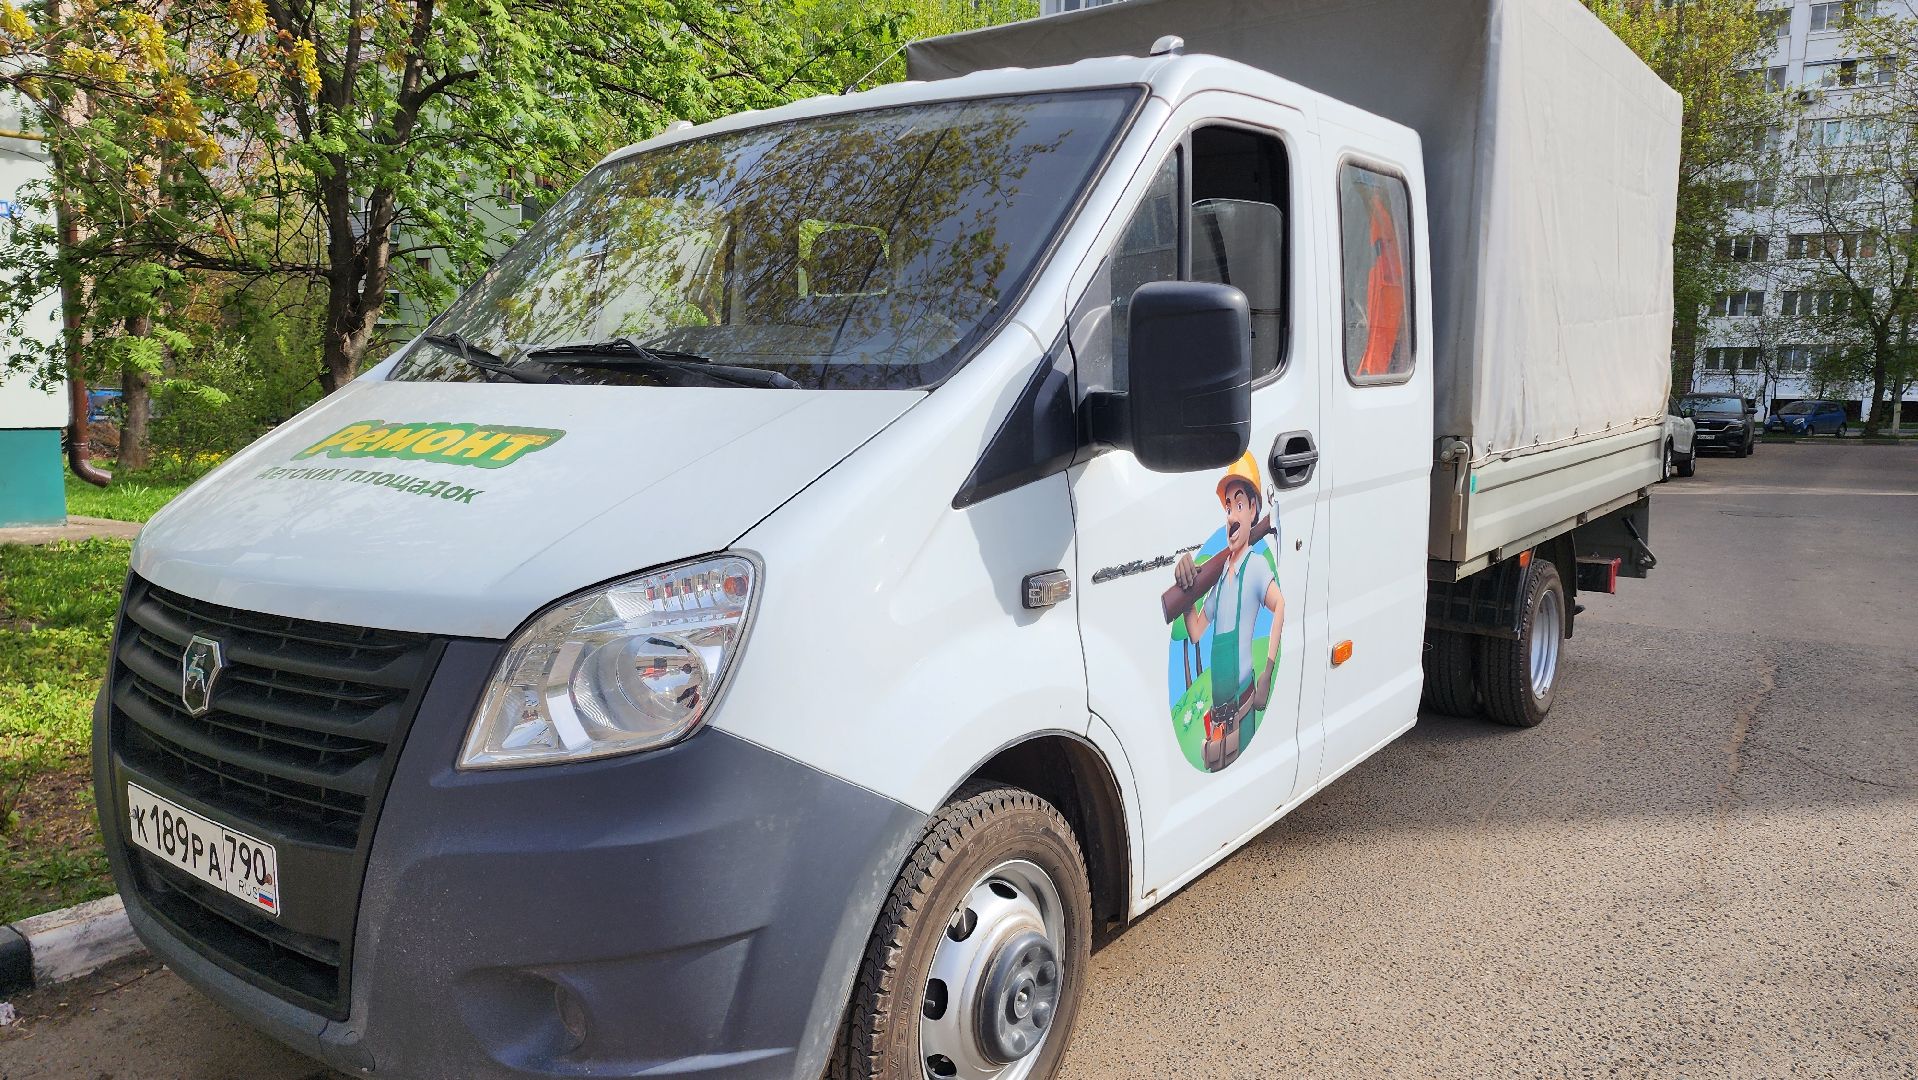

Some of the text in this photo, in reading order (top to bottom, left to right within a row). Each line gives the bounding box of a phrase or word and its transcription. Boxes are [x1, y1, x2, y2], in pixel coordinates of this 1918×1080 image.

[343, 470, 485, 504] площадок
[224, 834, 267, 886] 790
[238, 879, 259, 900] RUS
